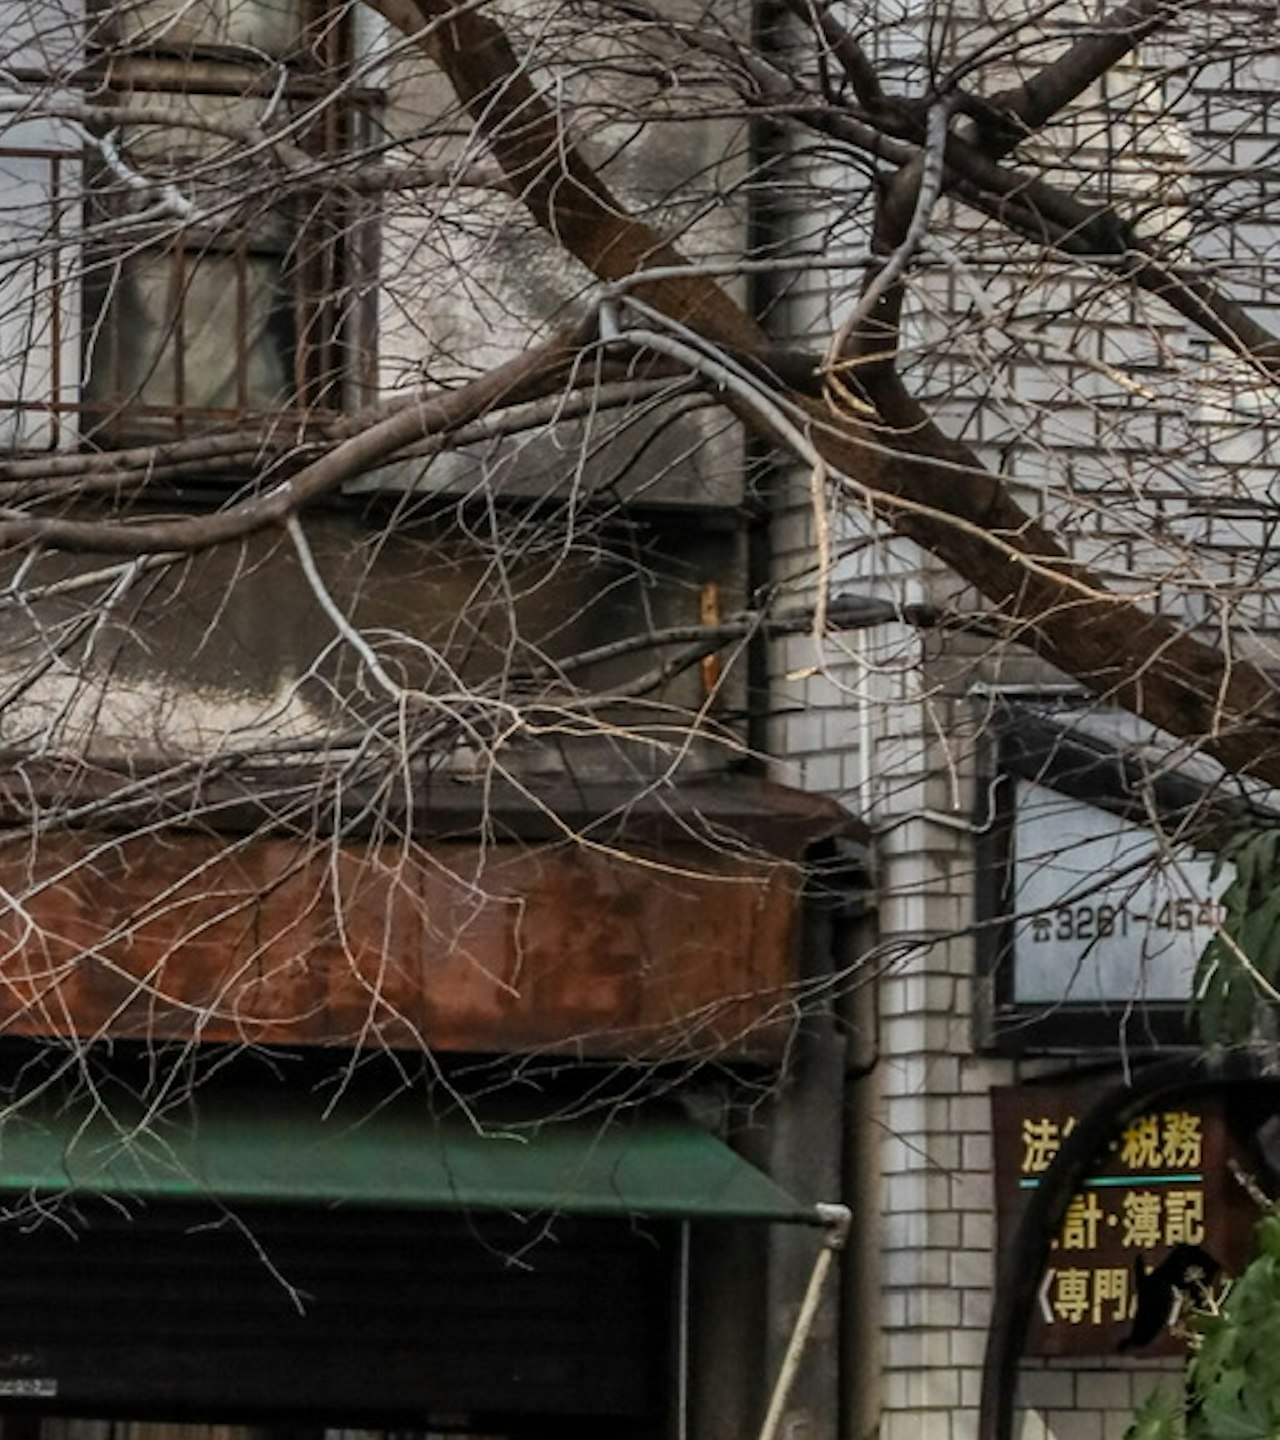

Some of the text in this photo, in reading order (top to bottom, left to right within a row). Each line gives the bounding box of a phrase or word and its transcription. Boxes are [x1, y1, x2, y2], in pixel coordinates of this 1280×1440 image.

[1020, 1111, 1203, 1173] 法・税務
[1048, 1191, 1206, 1250] 計・簿記
